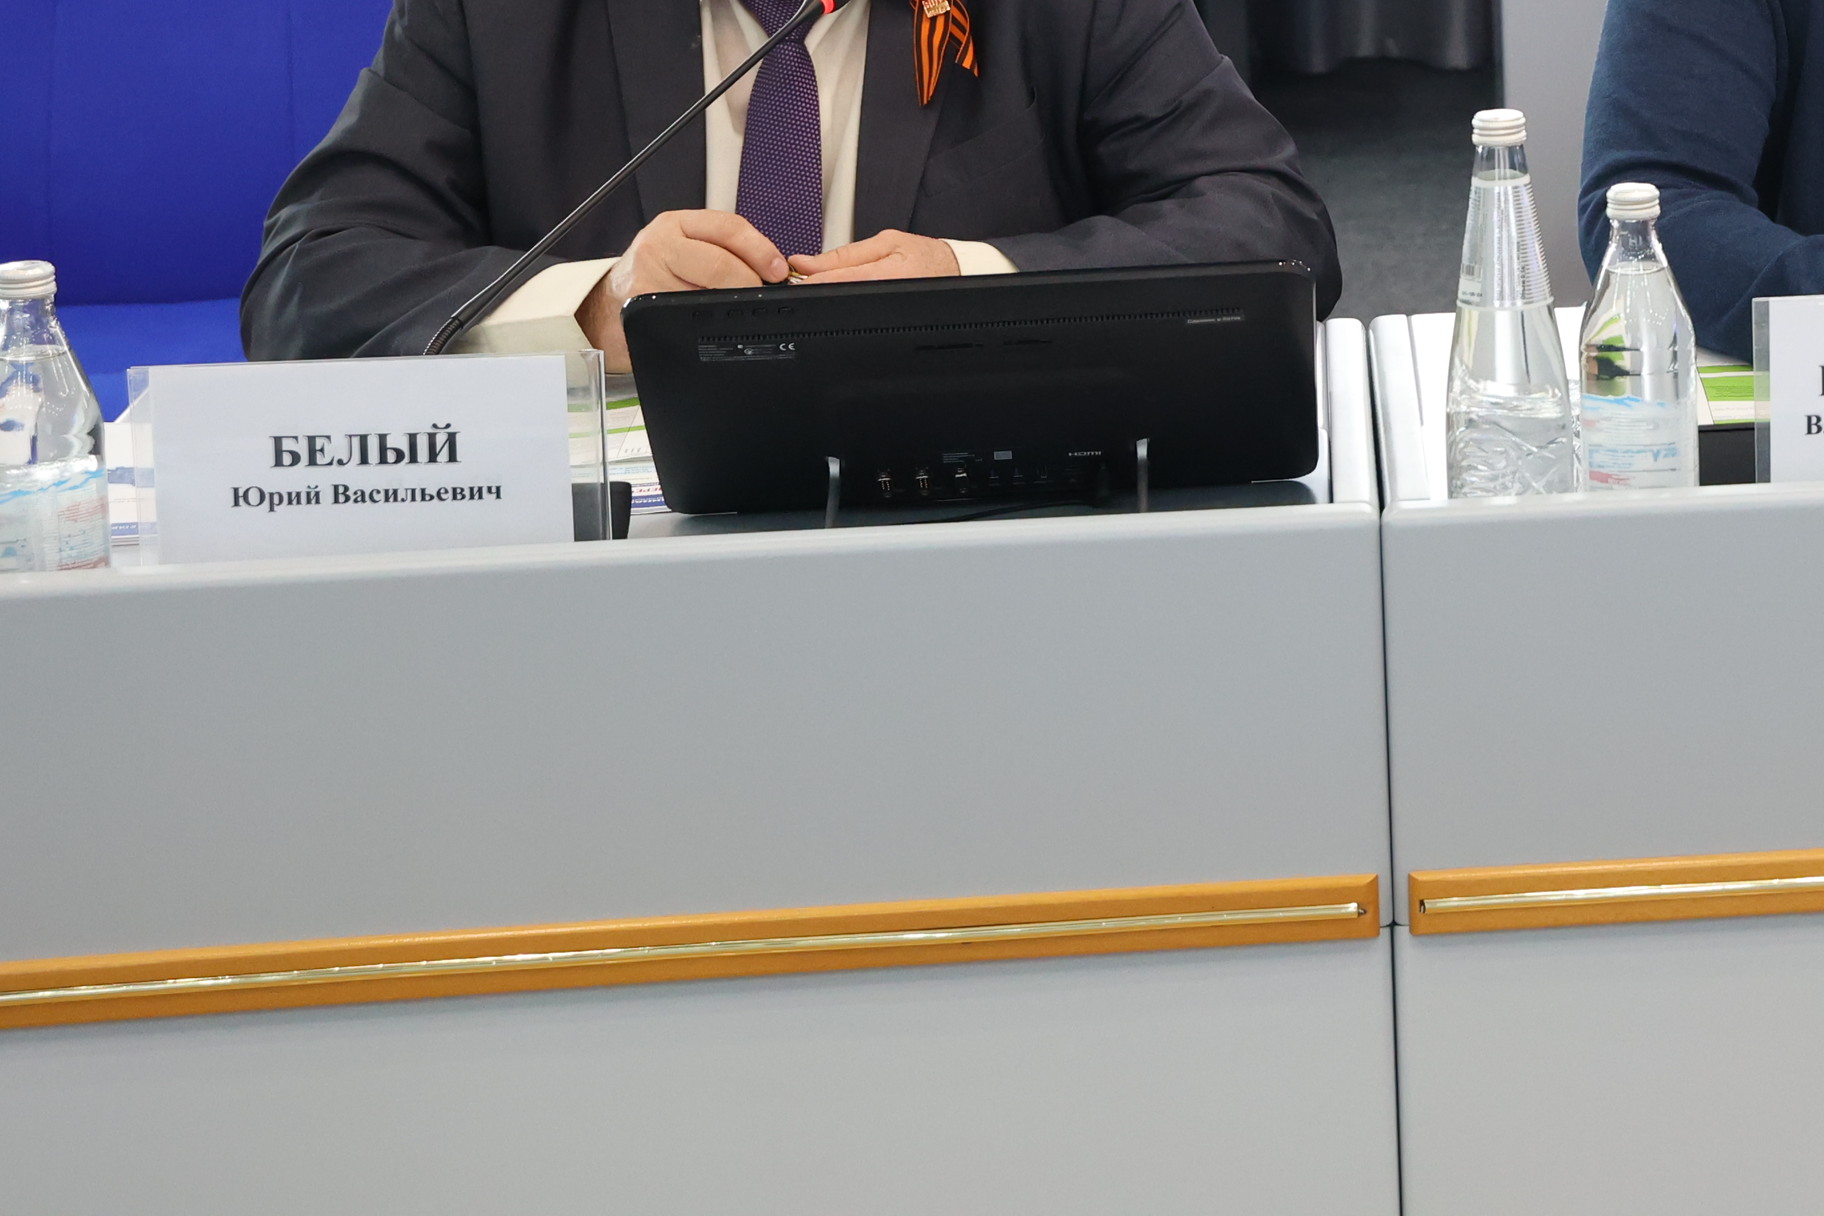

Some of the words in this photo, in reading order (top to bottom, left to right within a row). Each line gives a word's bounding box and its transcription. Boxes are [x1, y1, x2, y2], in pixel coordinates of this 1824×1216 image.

[268, 422, 461, 469] БЕЛЫЙ
[230, 484, 322, 513] Юрий
[331, 482, 503, 506] Васильевич
